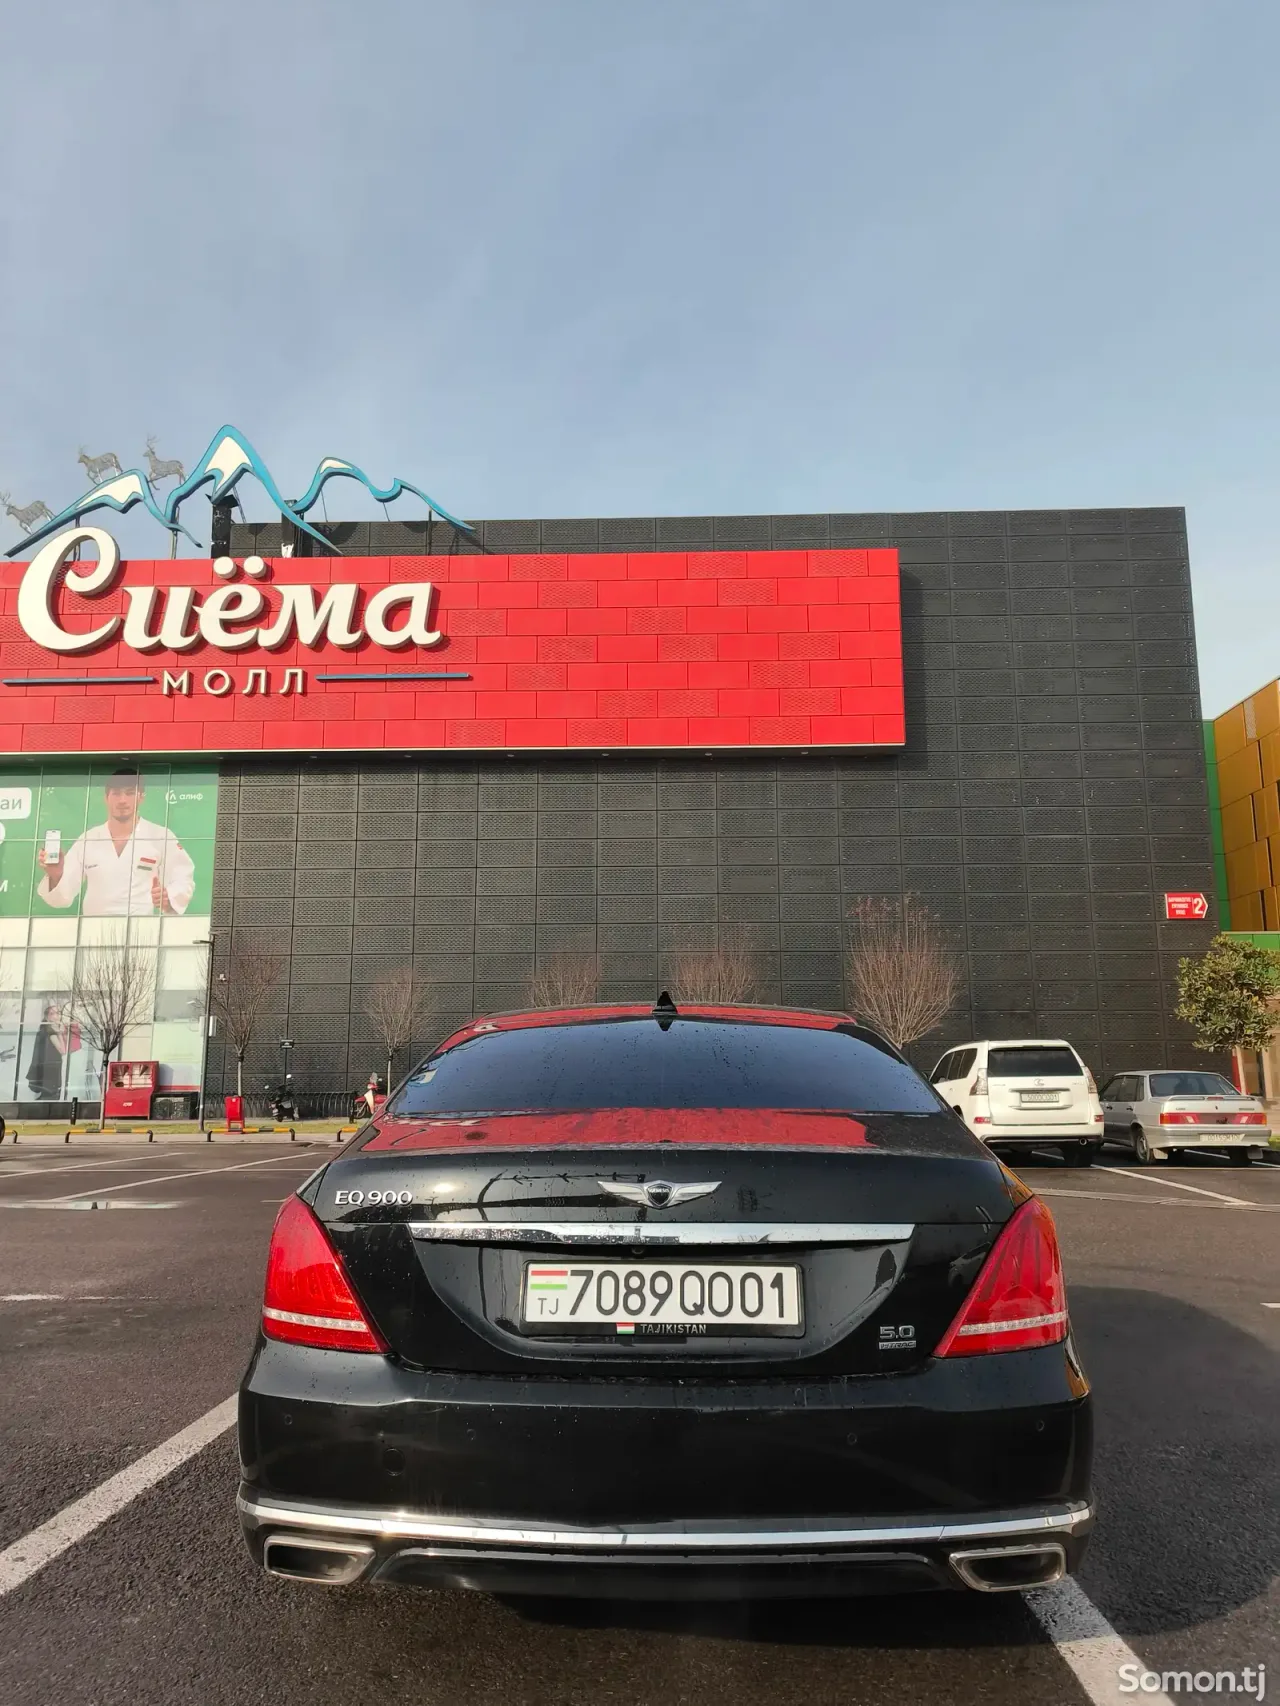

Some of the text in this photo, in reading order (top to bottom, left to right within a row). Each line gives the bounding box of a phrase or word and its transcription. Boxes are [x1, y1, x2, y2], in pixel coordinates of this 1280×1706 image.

[17, 526, 444, 653] Сиёма
[162, 668, 306, 697] МОЛЛ
[1193, 897, 1204, 914] 2
[334, 1190, 413, 1207] EQ 900
[538, 1297, 560, 1315] TJ
[640, 1323, 707, 1334] TAJIKISTAN
[879, 1325, 915, 1339] 5.0
